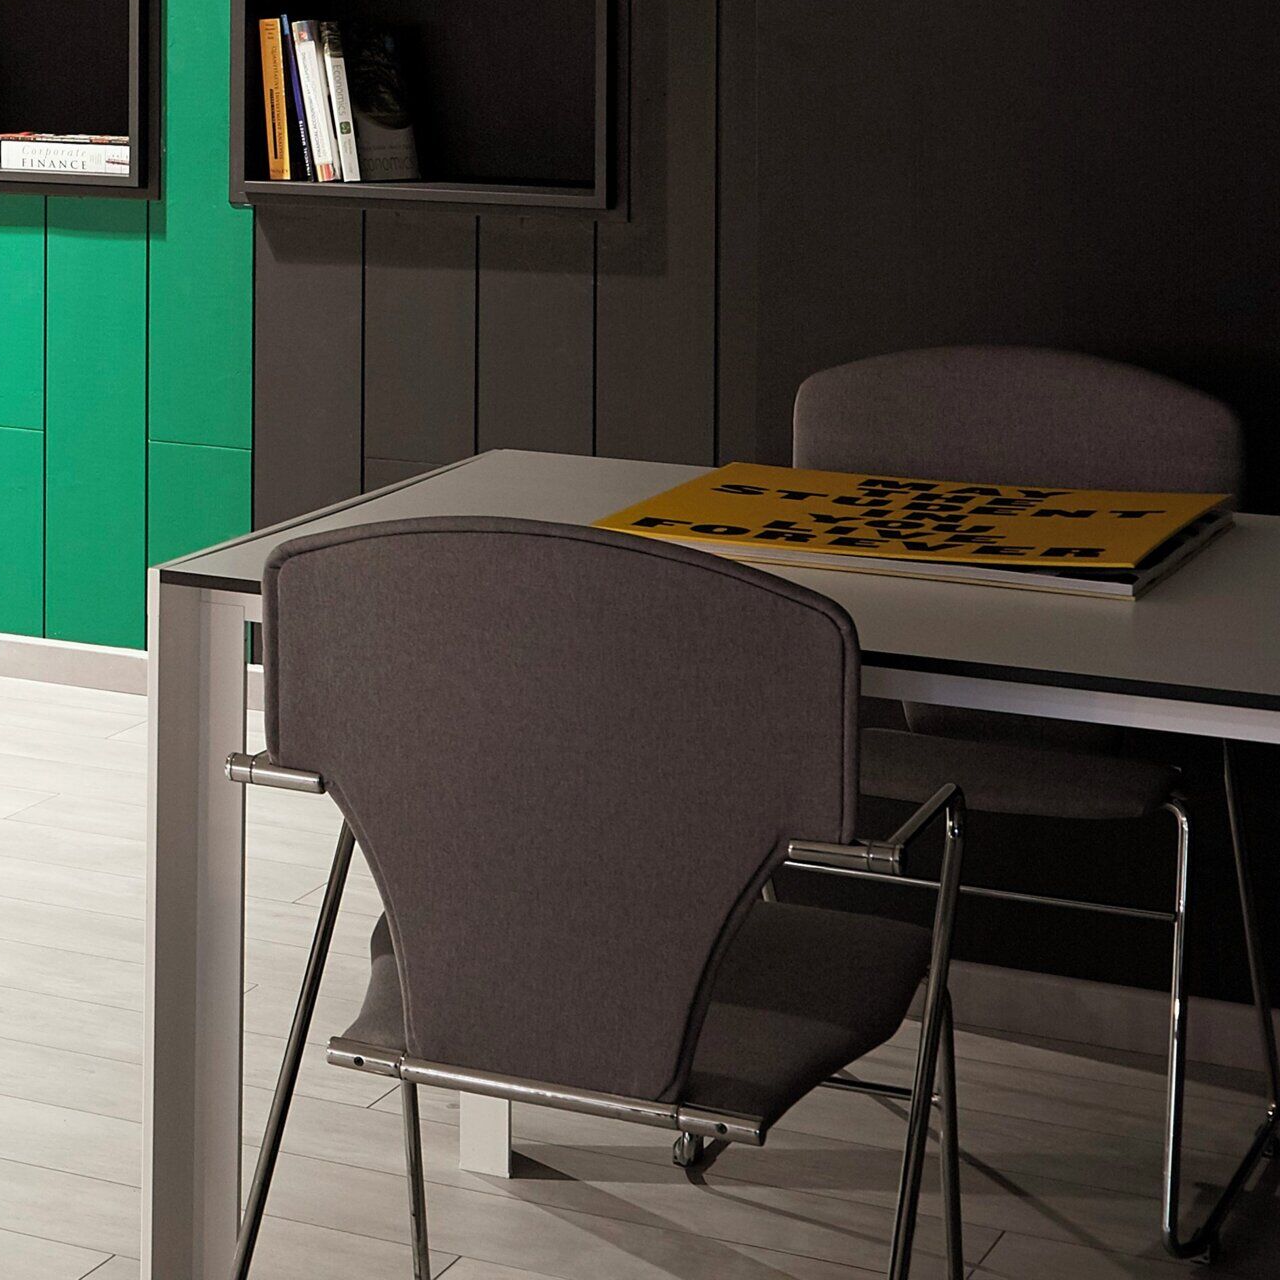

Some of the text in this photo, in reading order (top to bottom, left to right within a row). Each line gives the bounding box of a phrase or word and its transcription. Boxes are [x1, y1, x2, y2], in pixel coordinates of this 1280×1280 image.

[332, 64, 348, 116] Economics
[21, 145, 87, 159] Corporate
[21, 158, 87, 170] FINANCE
[857, 487, 1044, 507] THE
[858, 479, 1074, 499] MAY
[711, 484, 1167, 519] STUDENT
[808, 512, 996, 534] YOU
[859, 509, 970, 523] IN
[631, 517, 1106, 558] FOREVER
[763, 520, 1007, 544] LIVE
